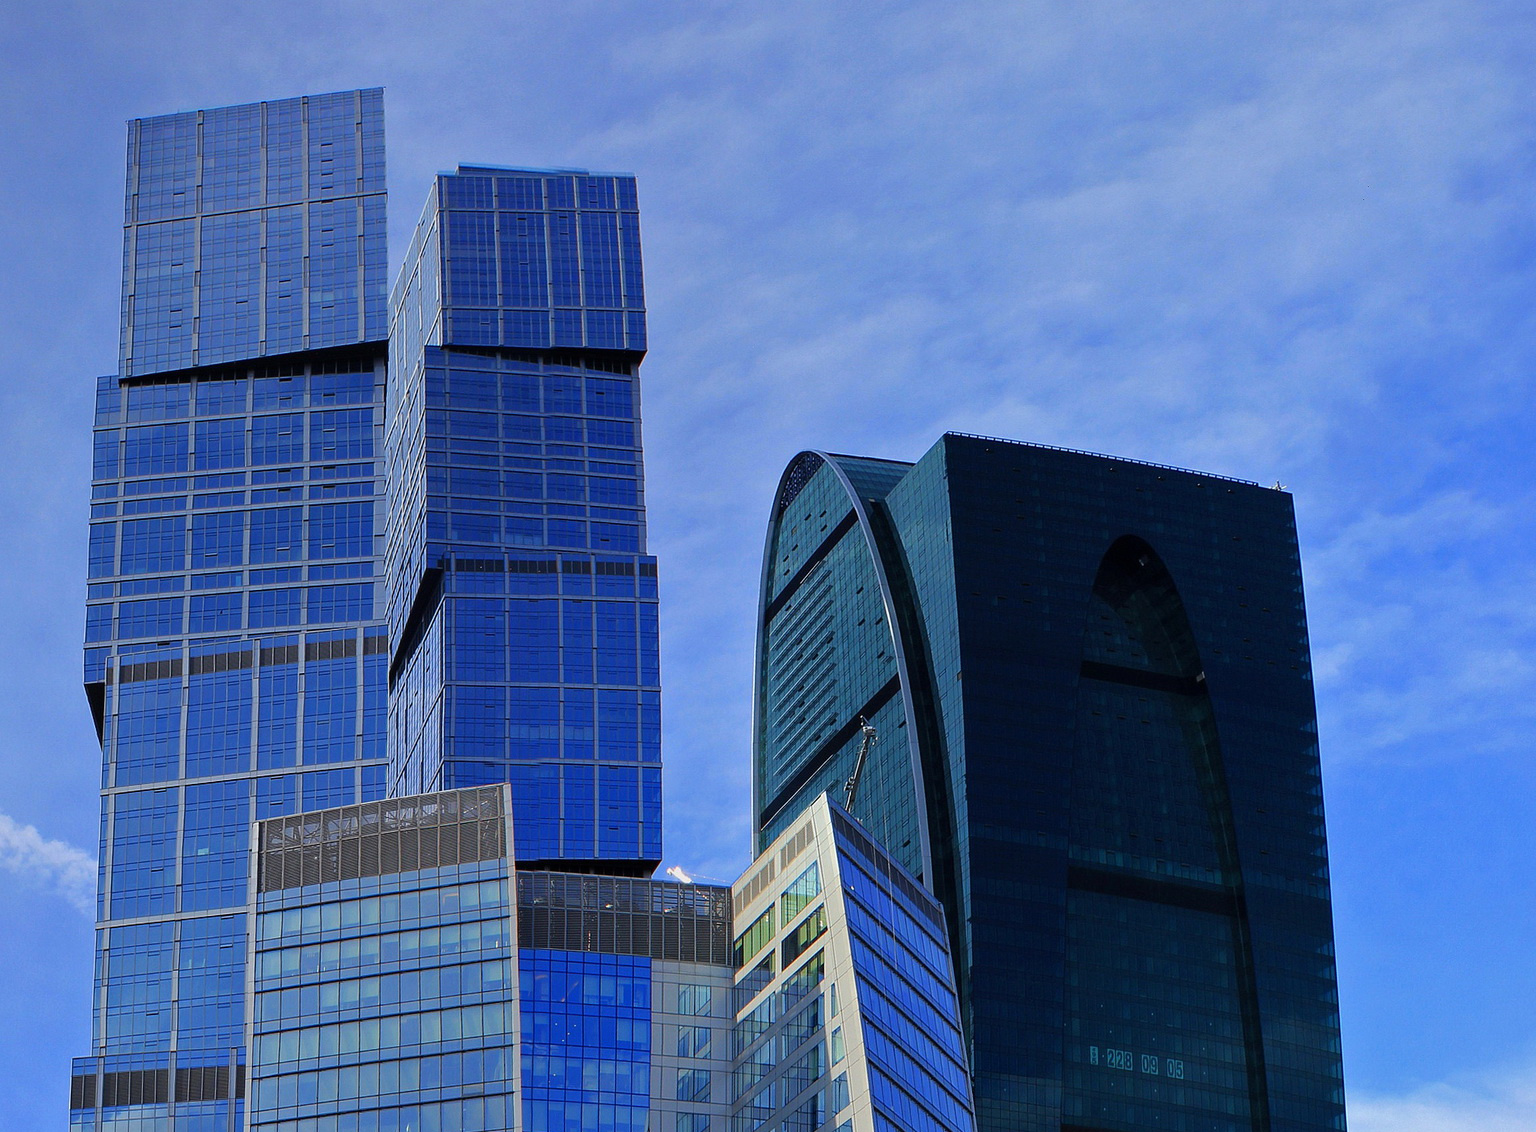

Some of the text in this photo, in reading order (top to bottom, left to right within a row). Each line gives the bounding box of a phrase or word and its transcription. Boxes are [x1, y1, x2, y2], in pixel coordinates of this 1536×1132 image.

[1107, 1048, 1133, 1071] 228
[1141, 1054, 1159, 1075] 09
[1166, 1058, 1184, 1080] 05
